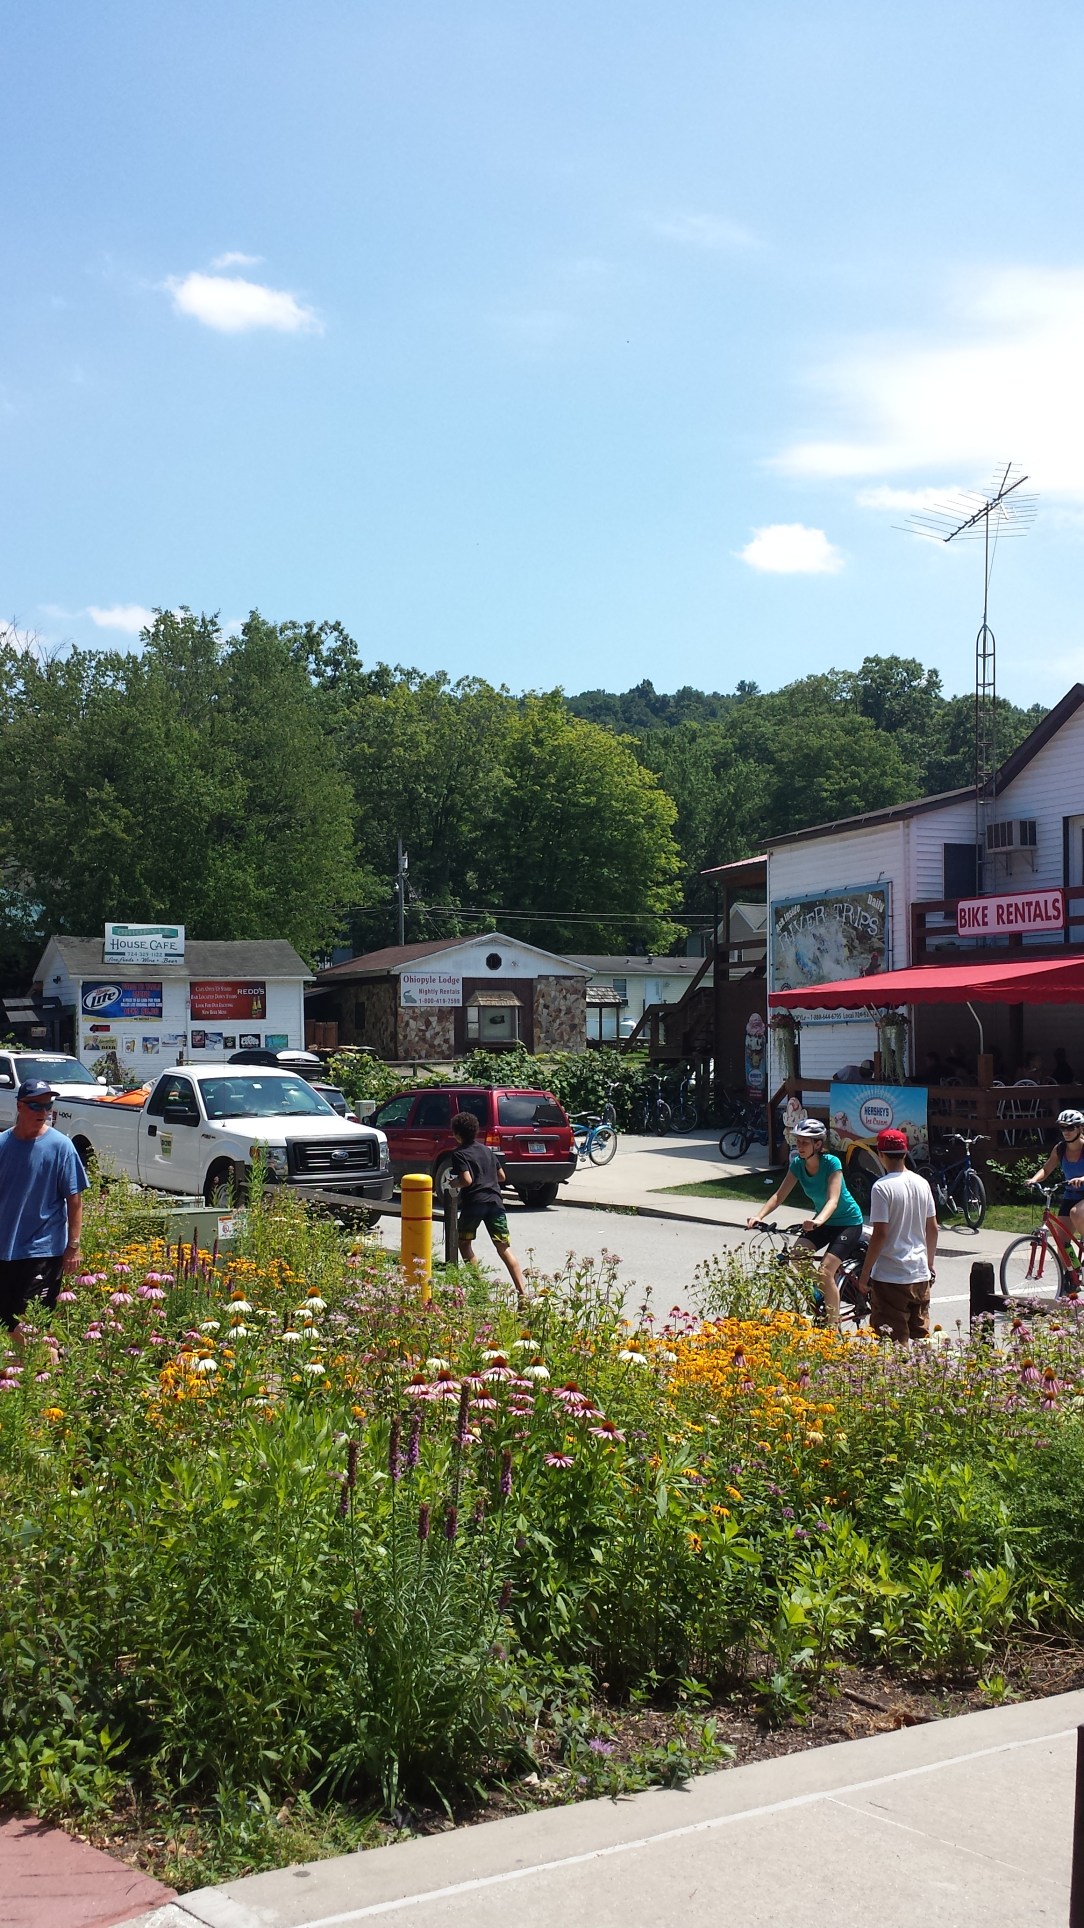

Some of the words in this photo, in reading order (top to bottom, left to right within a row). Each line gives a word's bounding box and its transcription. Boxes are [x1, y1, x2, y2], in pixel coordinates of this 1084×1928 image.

[868, 894, 884, 912] Daily
[784, 904, 800, 922] Inside
[960, 906, 988, 928] BIKE
[996, 898, 1061, 925] RENTALS
[778, 906, 826, 951] RIVER
[833, 903, 879, 936] TRIPS
[110, 938, 148, 950] HOUSE
[150, 940, 177, 950] CAFE
[403, 975, 436, 984] Ohiopyle
[438, 976, 460, 985] Lodge
[91, 992, 116, 1008] Lite
[864, 1106, 889, 1117] HERSHEY'S
[873, 1117, 887, 1126] Cream
